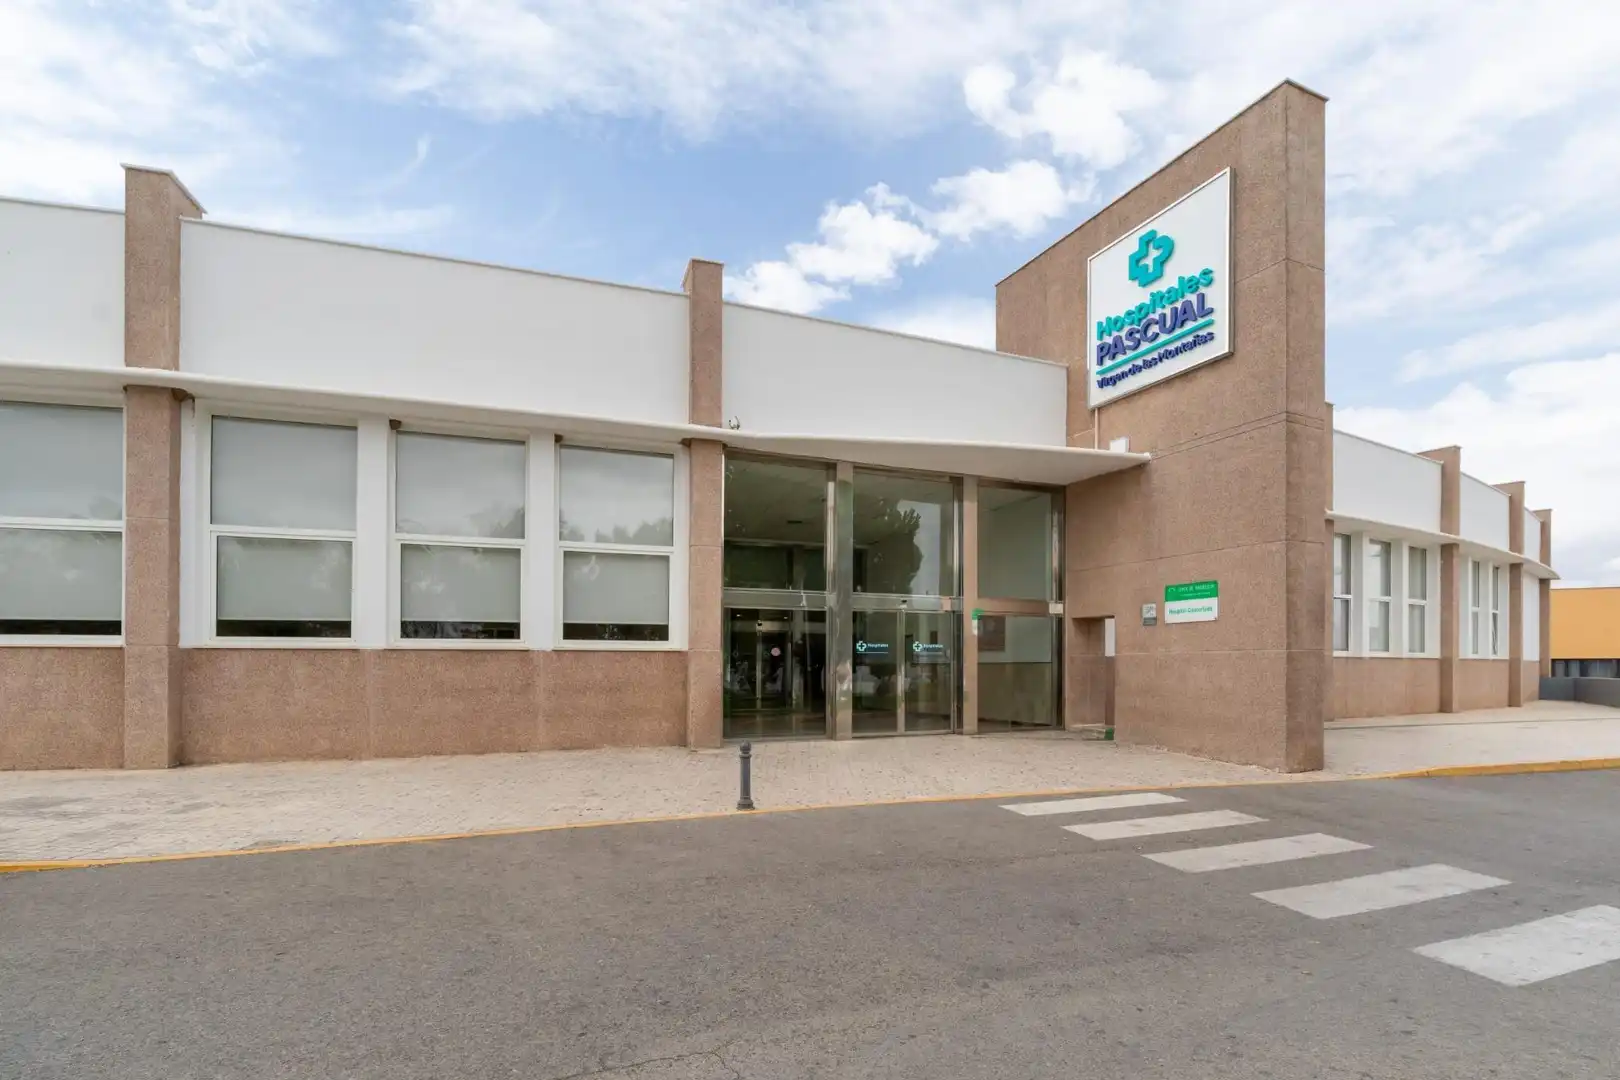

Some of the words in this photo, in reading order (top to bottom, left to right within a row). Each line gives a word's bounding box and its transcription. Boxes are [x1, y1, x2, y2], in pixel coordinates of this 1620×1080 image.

[1096, 268, 1214, 341] Hospitales
[1096, 292, 1214, 366] PASCUAL
[1097, 370, 1129, 389] Virgen
[1128, 363, 1143, 376] de
[1142, 358, 1158, 370] las
[1158, 332, 1215, 362] Montañas
